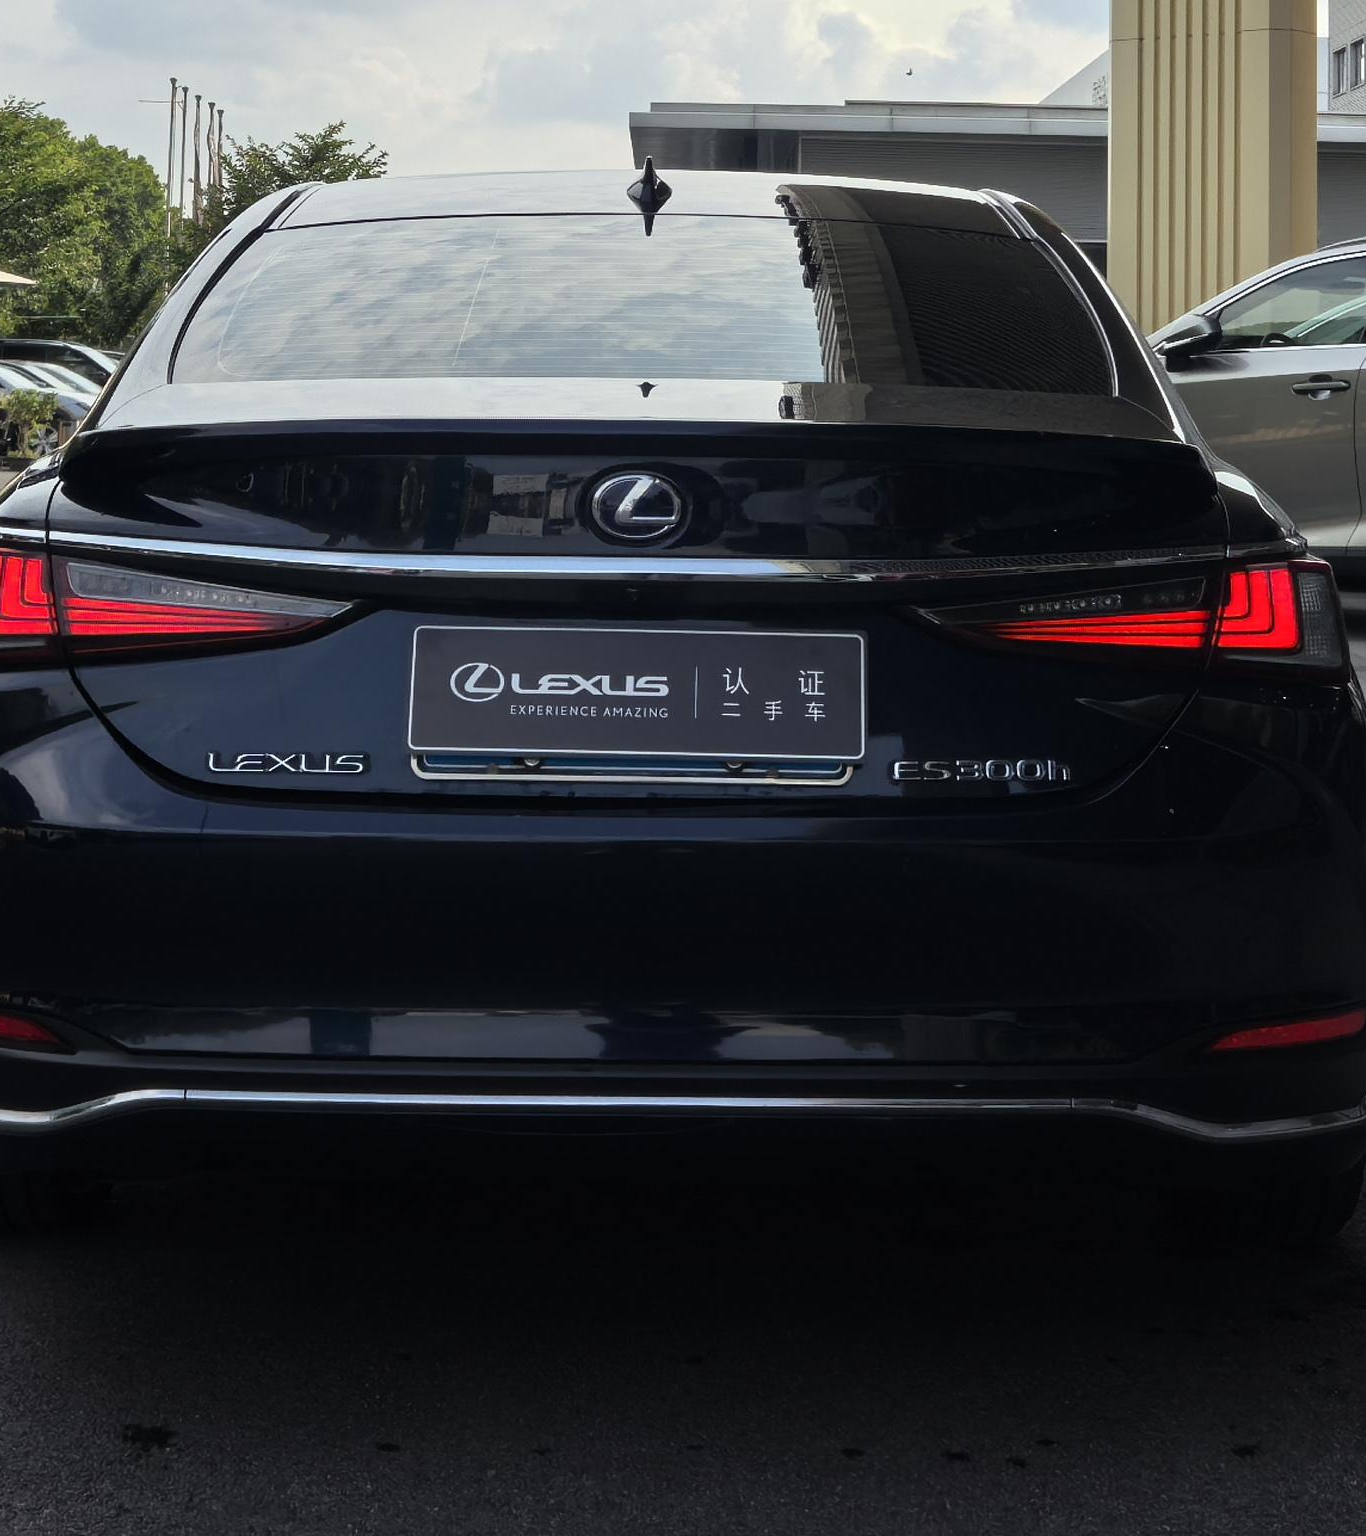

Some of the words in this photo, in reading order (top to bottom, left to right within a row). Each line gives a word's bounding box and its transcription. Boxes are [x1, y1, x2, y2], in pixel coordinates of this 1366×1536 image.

[511, 673, 670, 697] LEXUS
[722, 666, 826, 696] 认证
[510, 704, 597, 717] EXPERIENCE
[603, 706, 669, 719] AMAZING
[720, 700, 826, 722] 二手车
[208, 752, 364, 773] LEXUS
[892, 759, 1071, 781] ES300h
